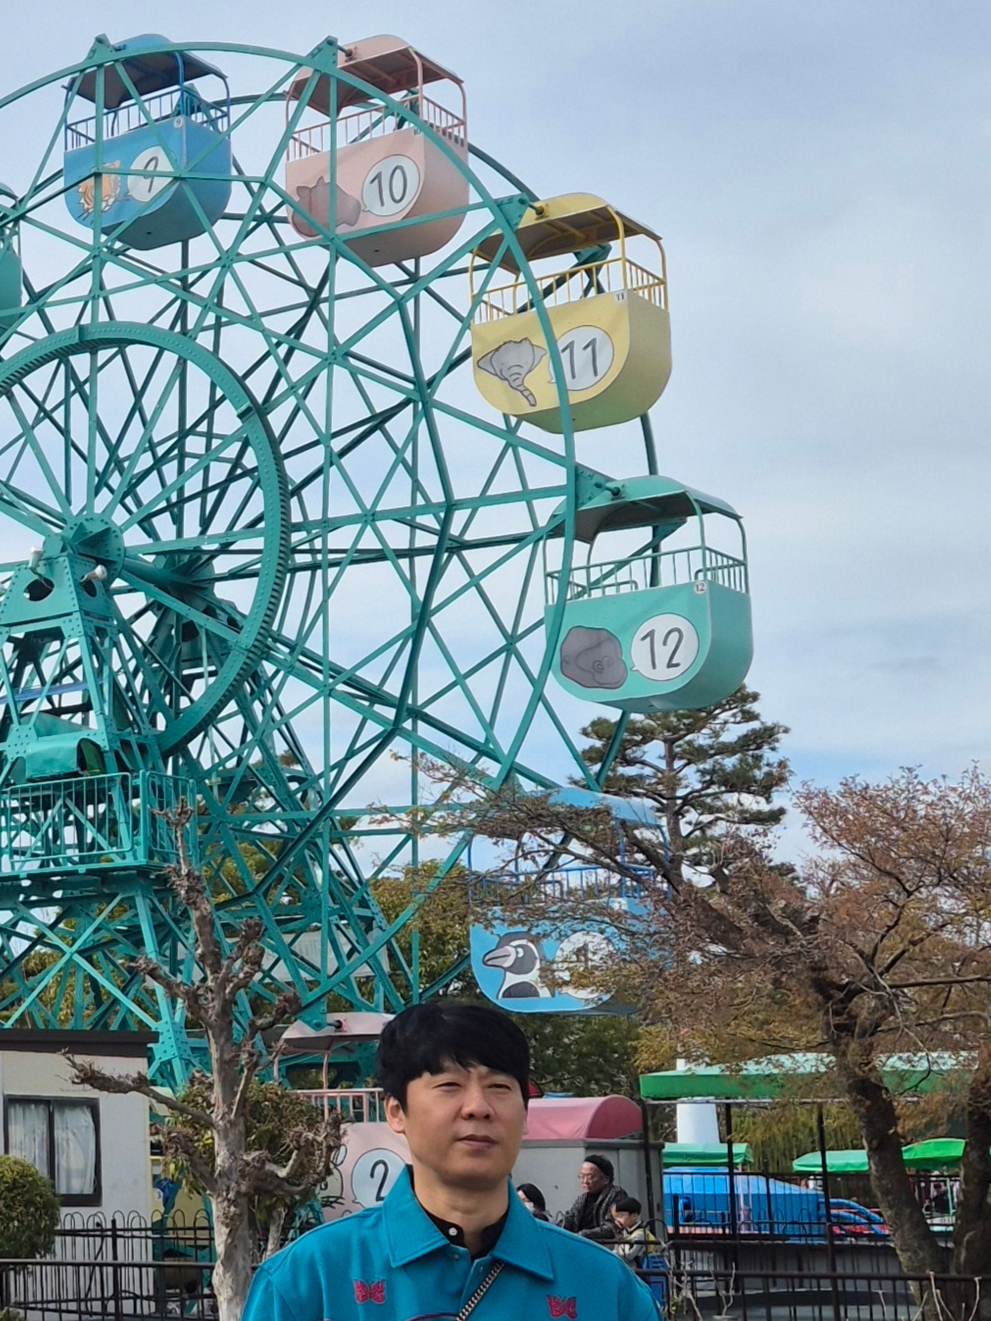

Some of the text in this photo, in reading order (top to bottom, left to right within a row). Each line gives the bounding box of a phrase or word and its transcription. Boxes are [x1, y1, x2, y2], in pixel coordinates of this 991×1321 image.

[143, 156, 159, 194] 9
[370, 165, 407, 207] 10
[616, 292, 625, 301] 11
[560, 337, 598, 380] 11
[696, 582, 705, 592] 12
[640, 626, 685, 670] 12
[370, 1159, 389, 1202] 2
